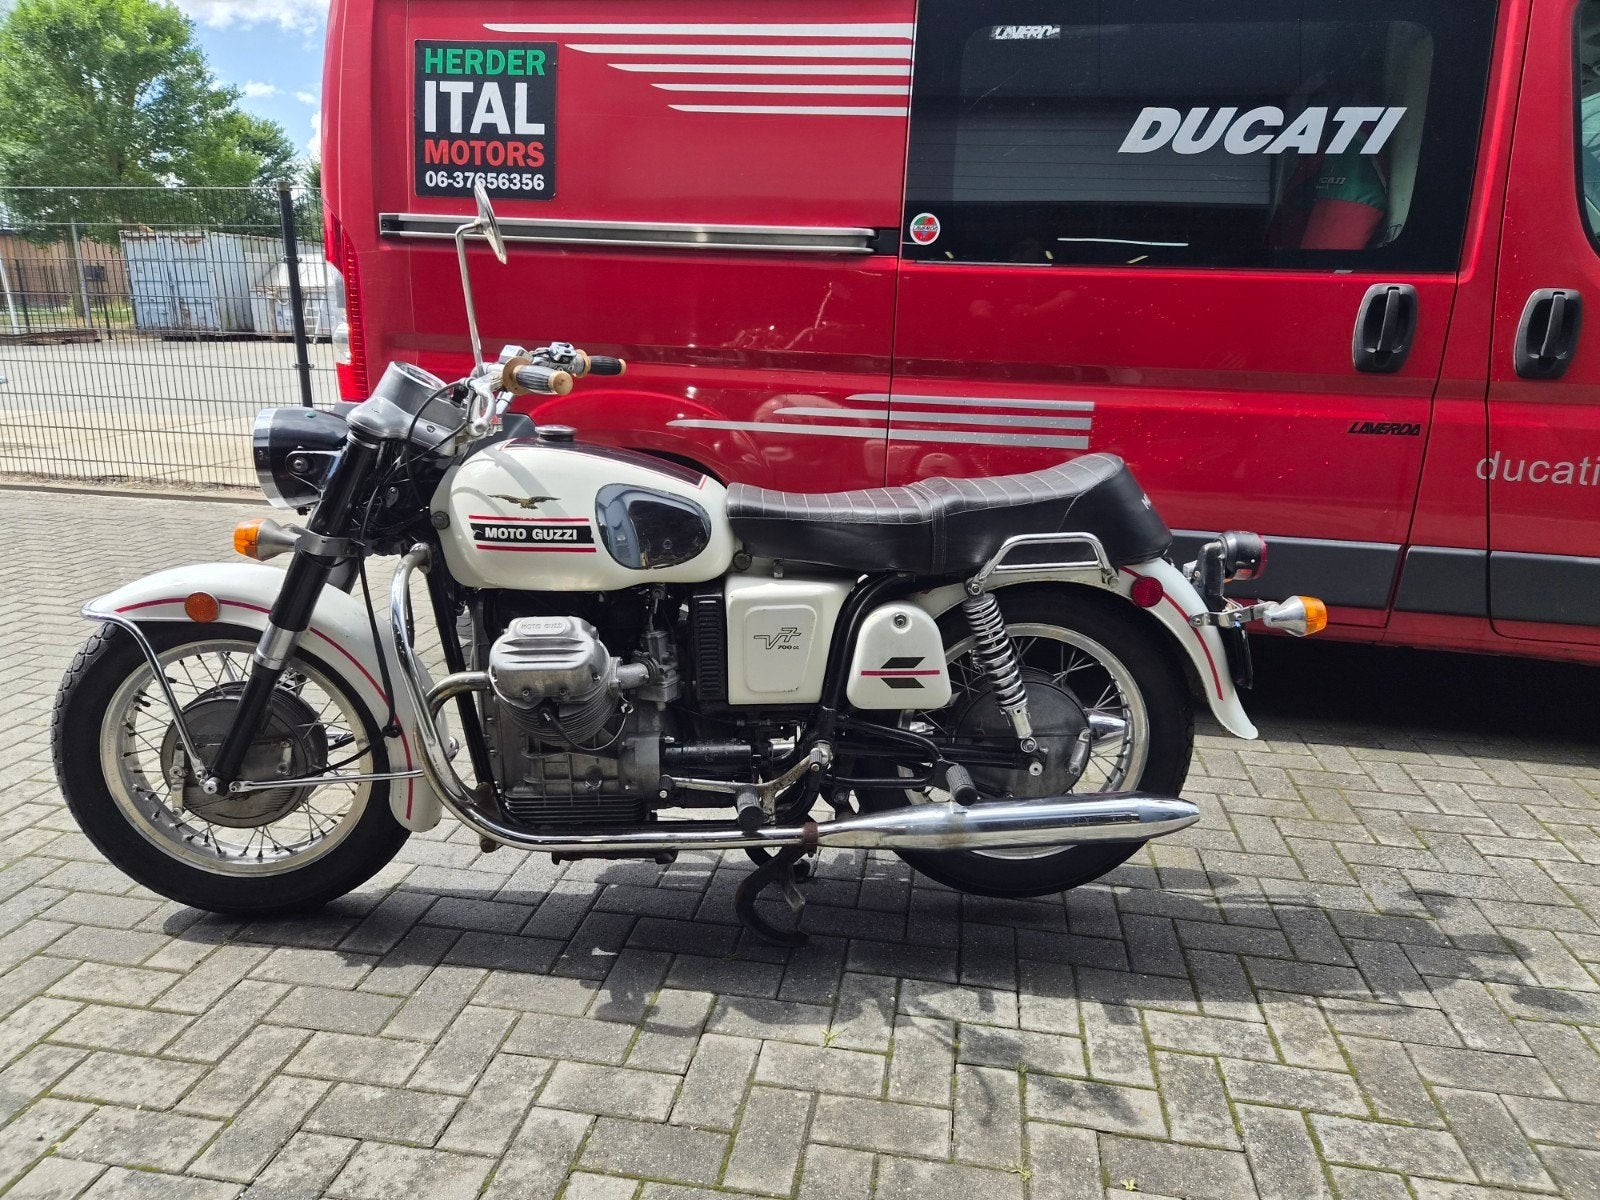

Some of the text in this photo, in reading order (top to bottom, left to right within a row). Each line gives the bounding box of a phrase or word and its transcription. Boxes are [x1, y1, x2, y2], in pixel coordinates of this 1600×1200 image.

[993, 25, 1060, 39] LAVERD
[425, 48, 545, 75] HERDER
[424, 80, 545, 135] ITAL
[1118, 106, 1407, 154] DUCATI
[424, 139, 545, 168] MOTORS
[425, 170, 545, 191] 06-37656356
[1347, 421, 1421, 436] LAVERDA
[1475, 450, 1600, 486] ducati
[485, 527, 578, 540] MOTO GUZZI
